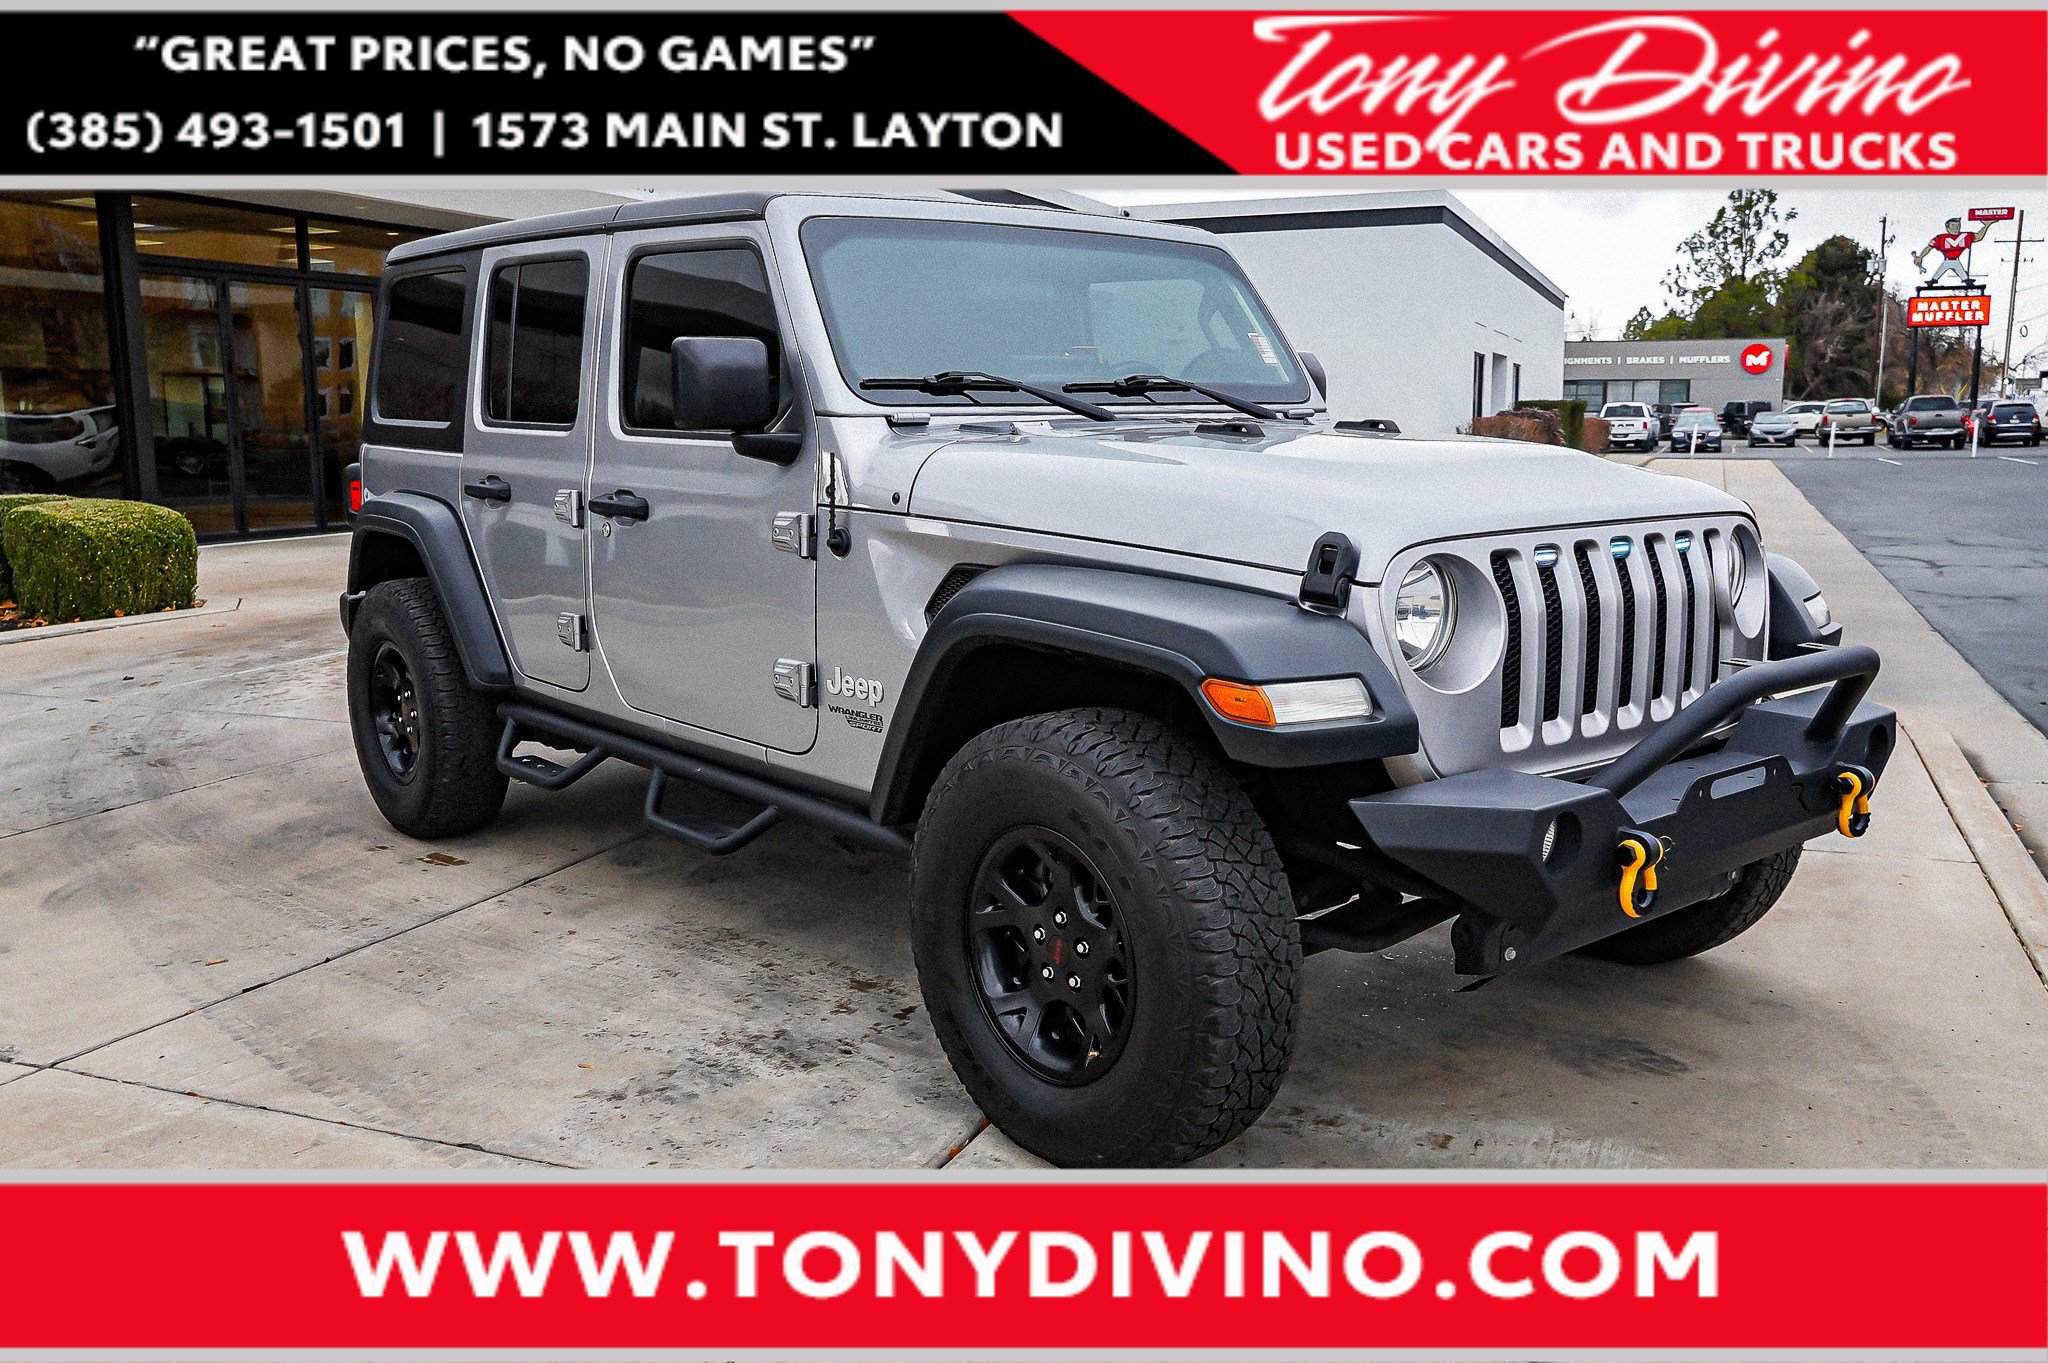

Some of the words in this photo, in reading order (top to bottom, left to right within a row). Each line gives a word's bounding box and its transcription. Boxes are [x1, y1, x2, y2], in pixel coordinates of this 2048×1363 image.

[1917, 300, 1981, 312] MASTER
[1911, 311, 1985, 323] MUFFLER
[1626, 356, 1665, 365] BRAKES
[1678, 355, 1731, 364] MUFFLERS
[826, 666, 884, 708] Jeep
[828, 704, 883, 722] WRANGLER
[849, 721, 883, 732] SPORT
